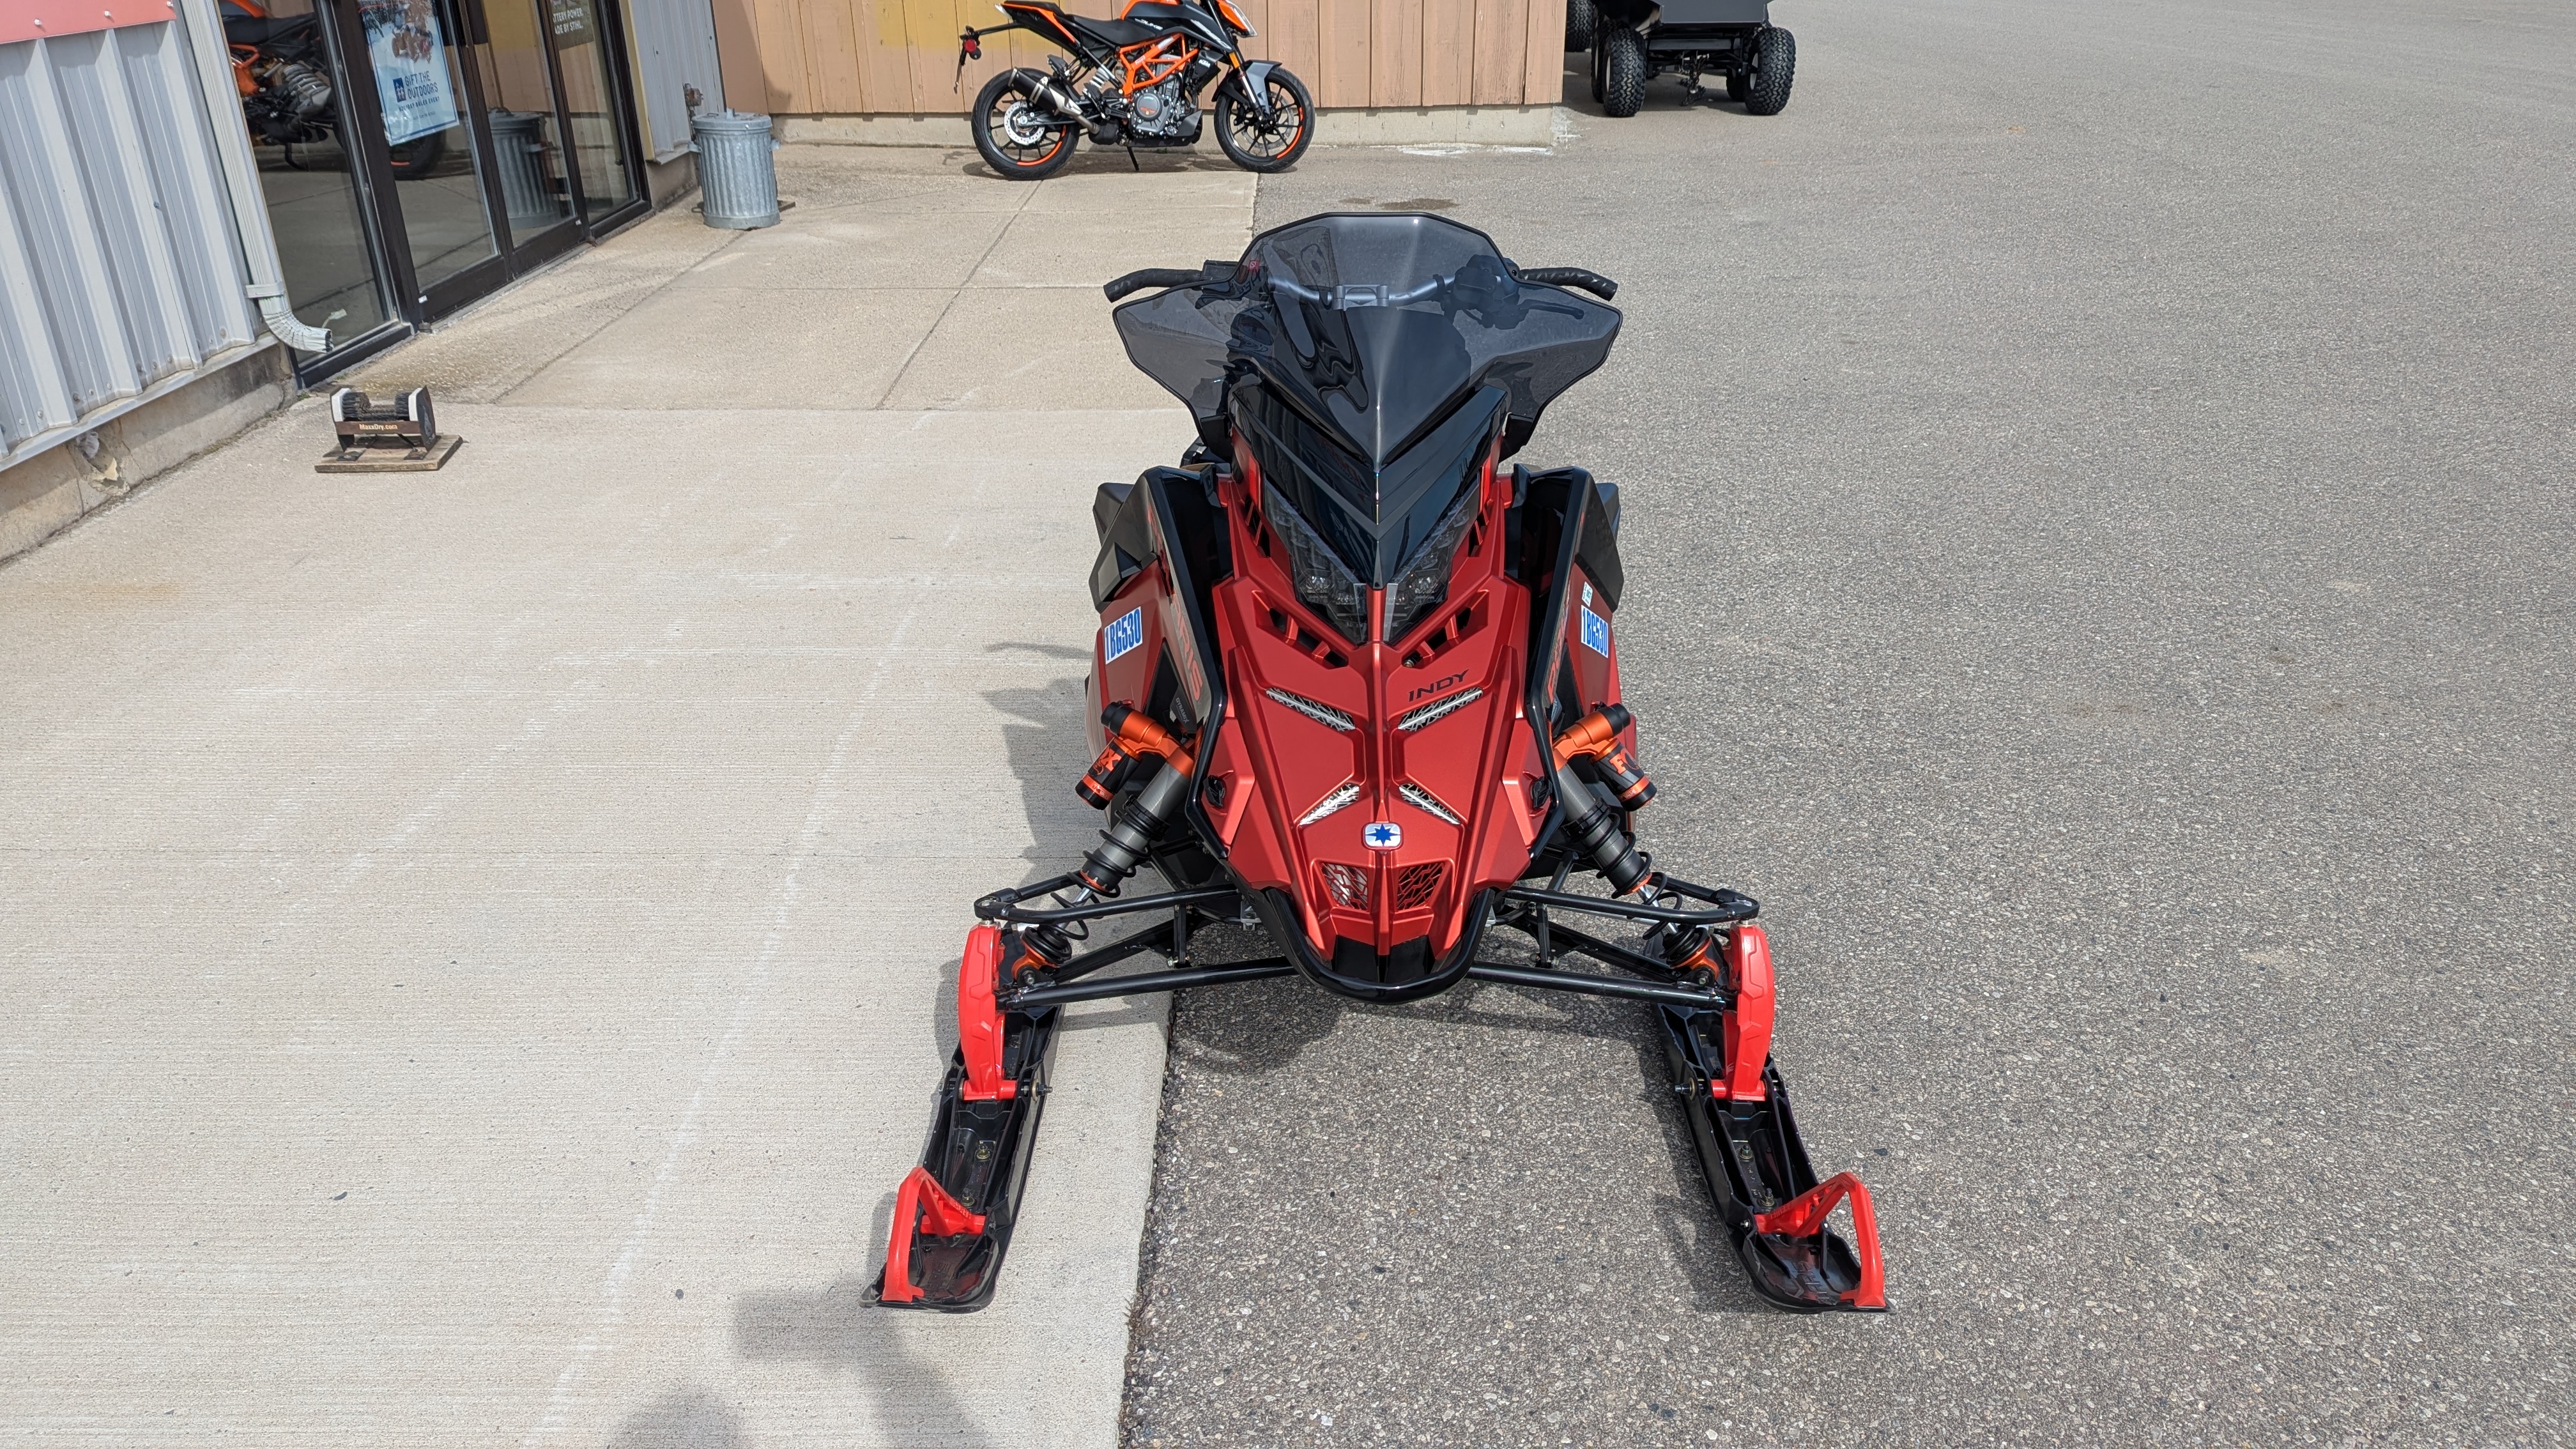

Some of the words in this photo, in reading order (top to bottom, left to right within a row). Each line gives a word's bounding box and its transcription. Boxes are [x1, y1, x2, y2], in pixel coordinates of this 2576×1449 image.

[564, 22, 569, 33] BY
[1199, 59, 1211, 68] KTM
[404, 73, 418, 87] GIFT
[419, 70, 431, 84] THE
[407, 82, 438, 99] OUTDOORS
[1105, 608, 1142, 662] 1BG530
[1582, 607, 1608, 657] 1BG530
[1409, 669, 1469, 702] INDY
[1175, 697, 1190, 724] DYNAMIX
[1609, 747, 1640, 775] FO
